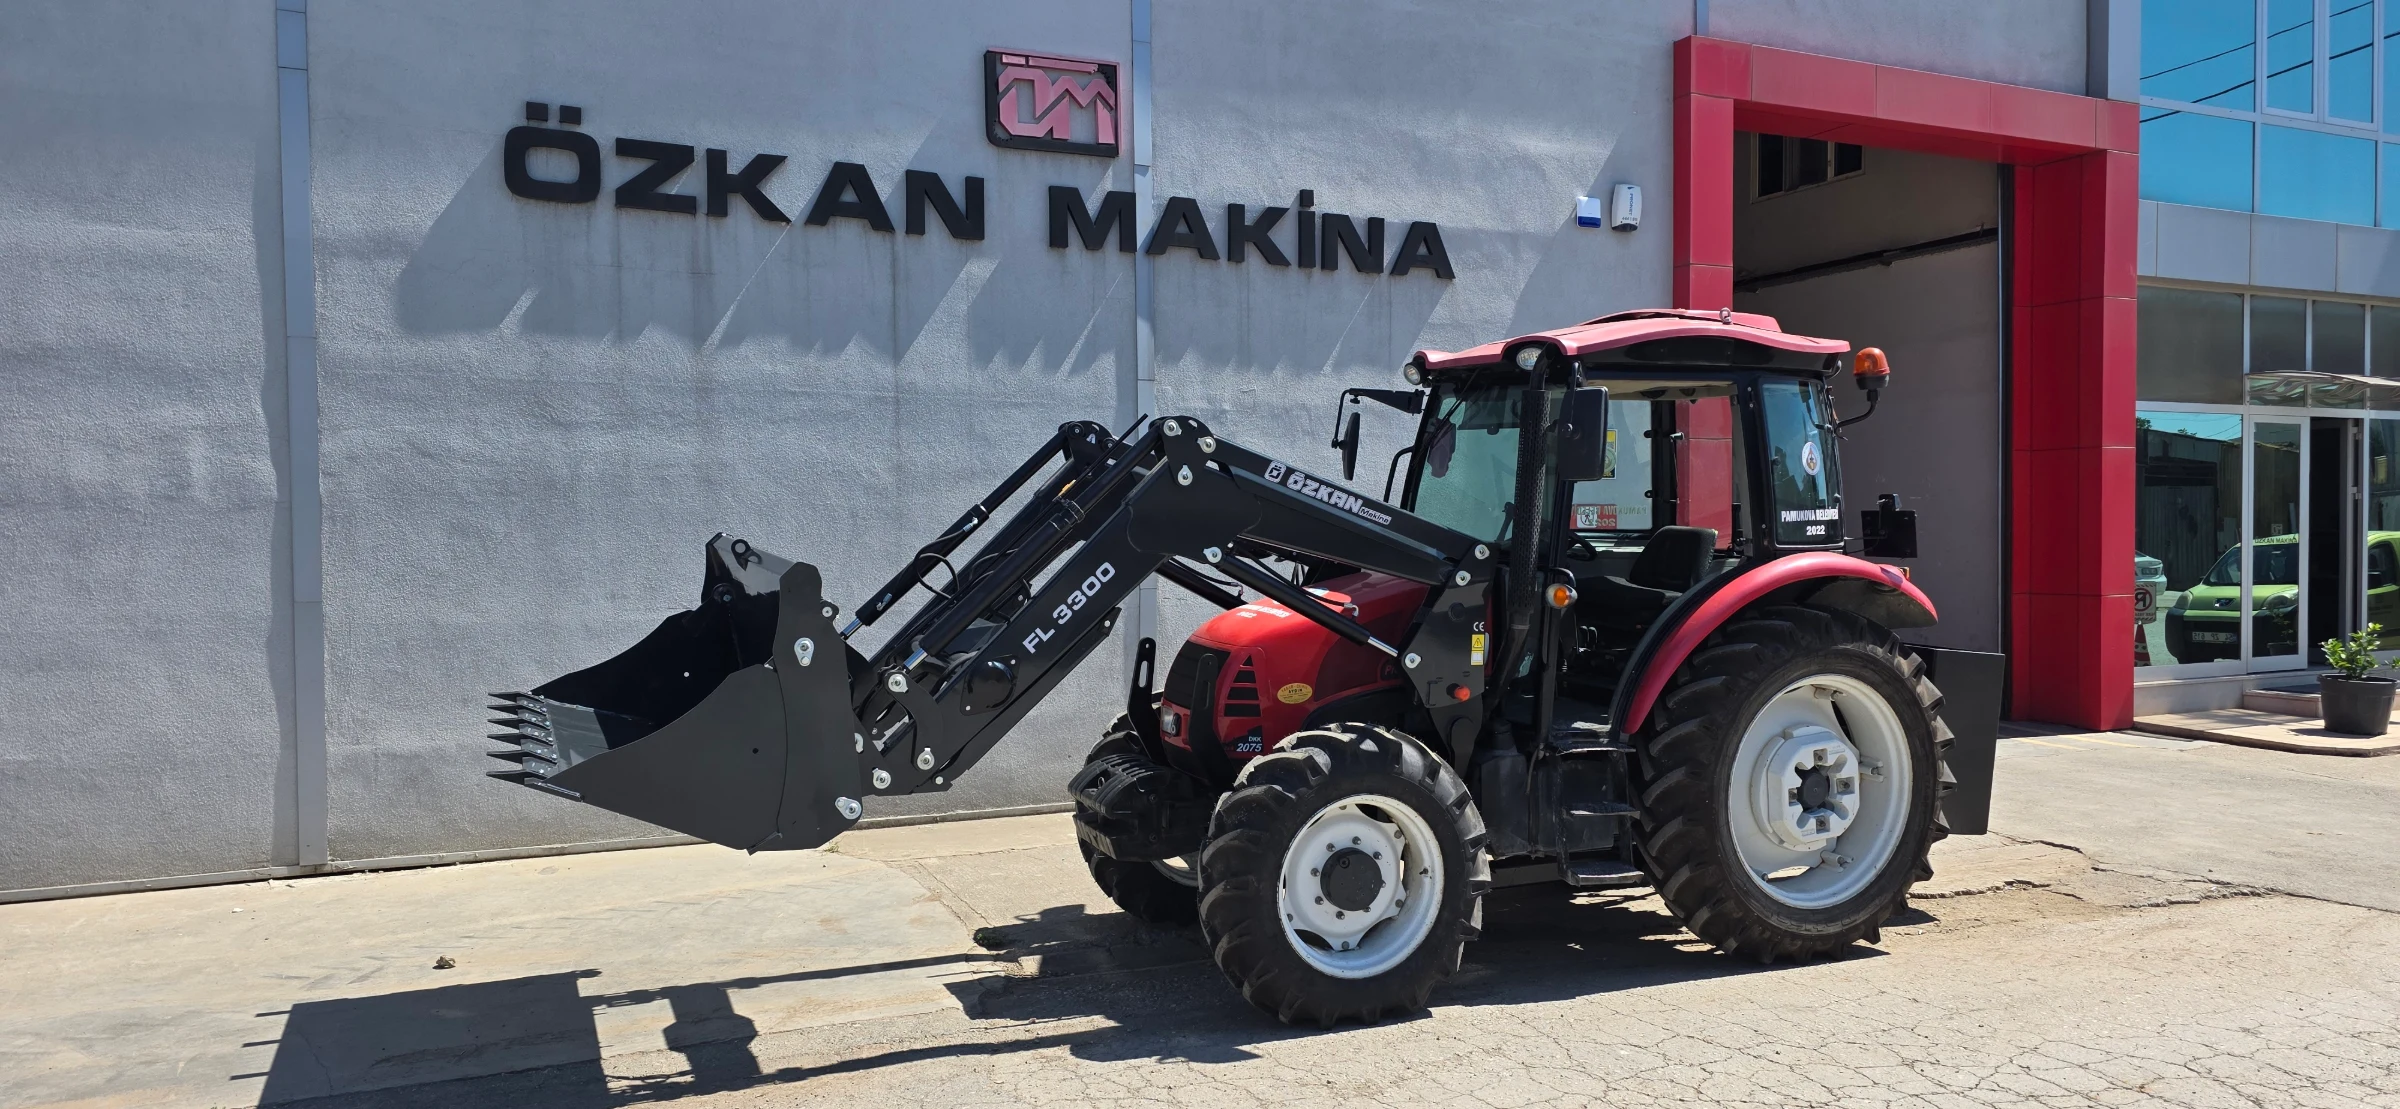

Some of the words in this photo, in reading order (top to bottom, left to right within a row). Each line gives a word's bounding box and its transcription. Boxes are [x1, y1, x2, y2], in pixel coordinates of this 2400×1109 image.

[503, 100, 986, 241] ÖZKAN
[1047, 186, 1456, 281] MAKİNA
[1286, 471, 1364, 514] ÖZKAN
[1781, 509, 1816, 522] PAMUKOVA
[1806, 525, 1826, 536] 2022
[1022, 627, 1056, 654] FL
[1052, 562, 1116, 625] 3300
[1236, 743, 1263, 752] 2075
